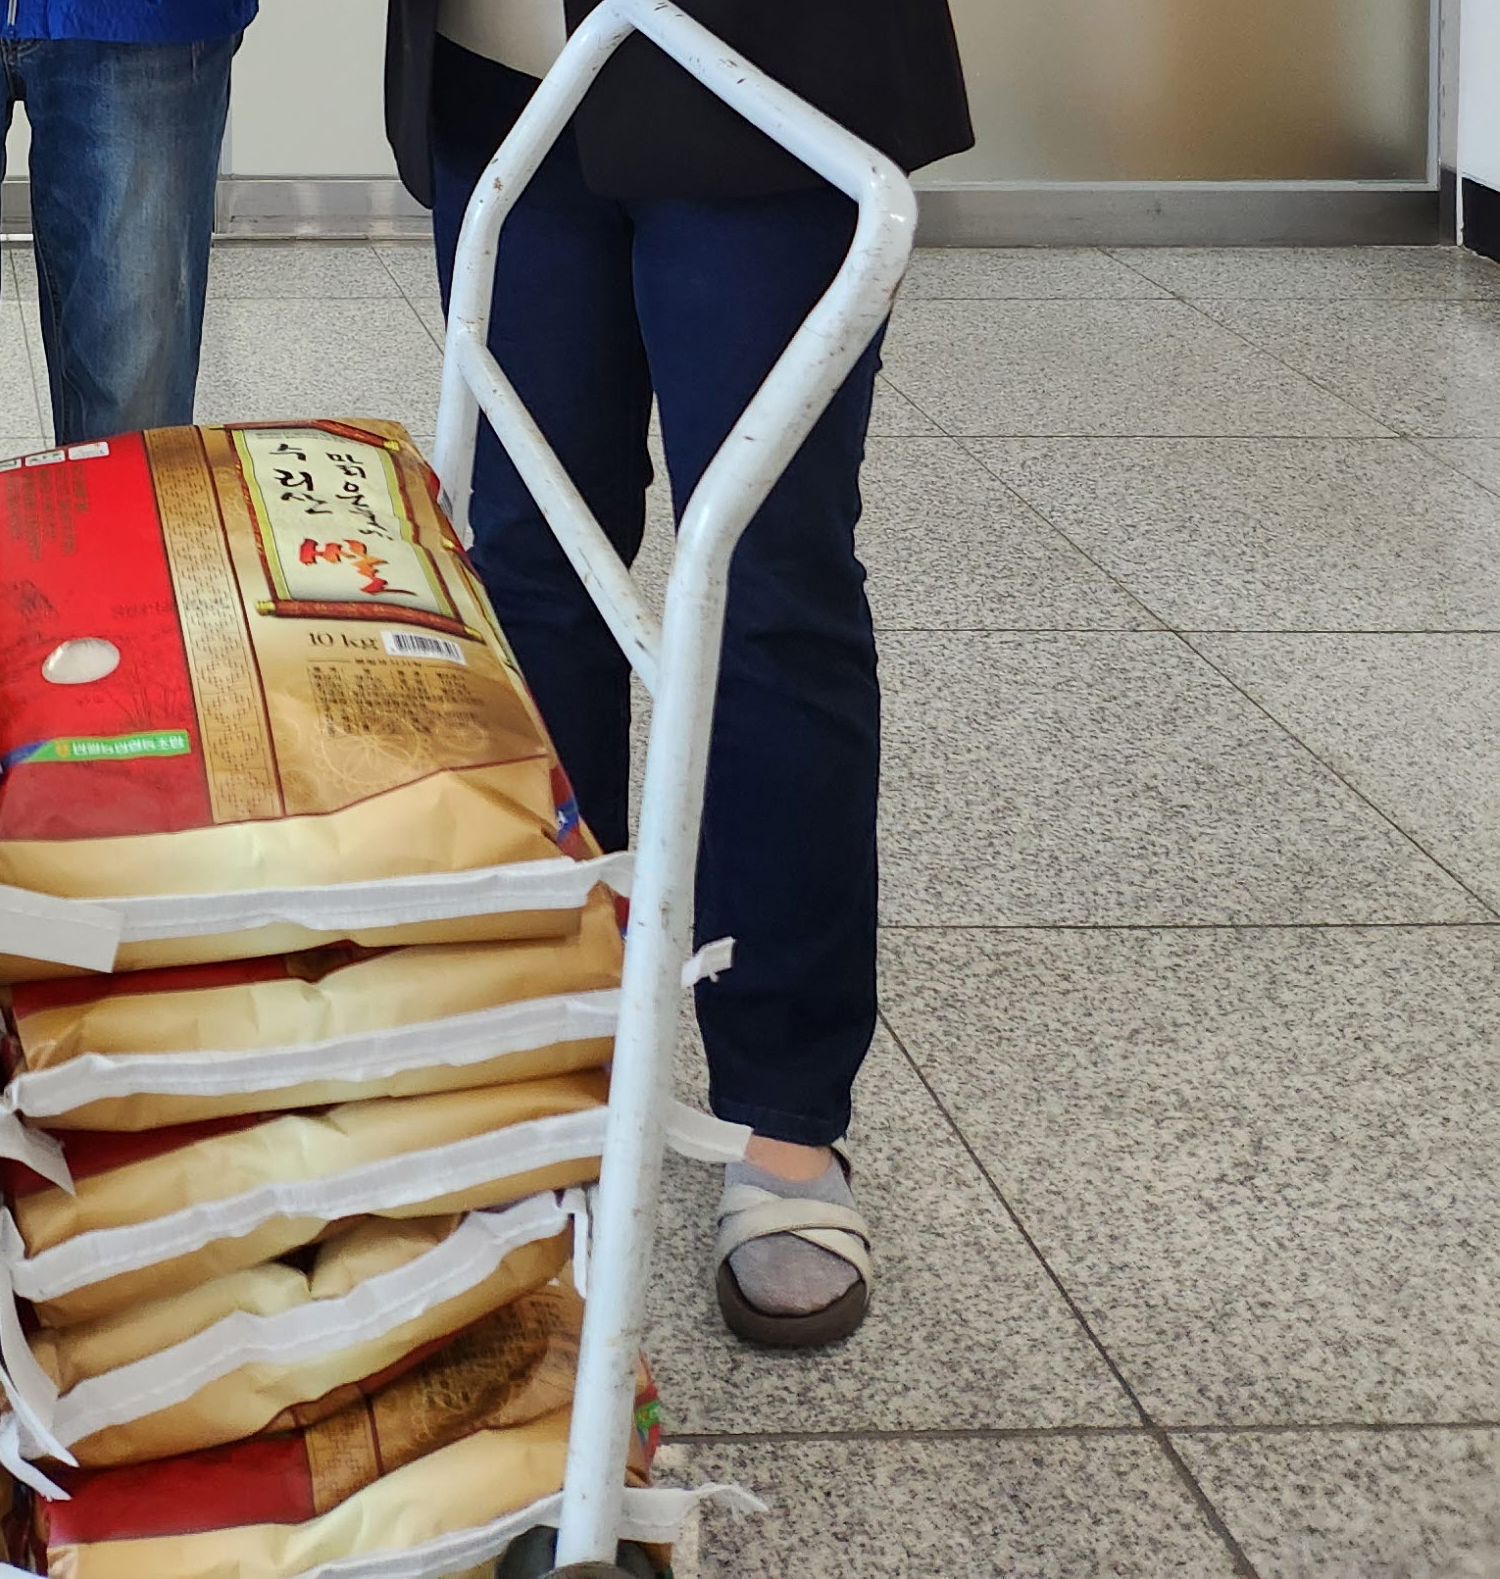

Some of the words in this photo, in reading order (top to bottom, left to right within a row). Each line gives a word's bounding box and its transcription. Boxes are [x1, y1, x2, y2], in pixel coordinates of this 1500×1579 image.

[269, 442, 333, 515] 수리산
[299, 537, 420, 596] 쌀
[306, 631, 336, 647] 10
[341, 635, 379, 653] kg
